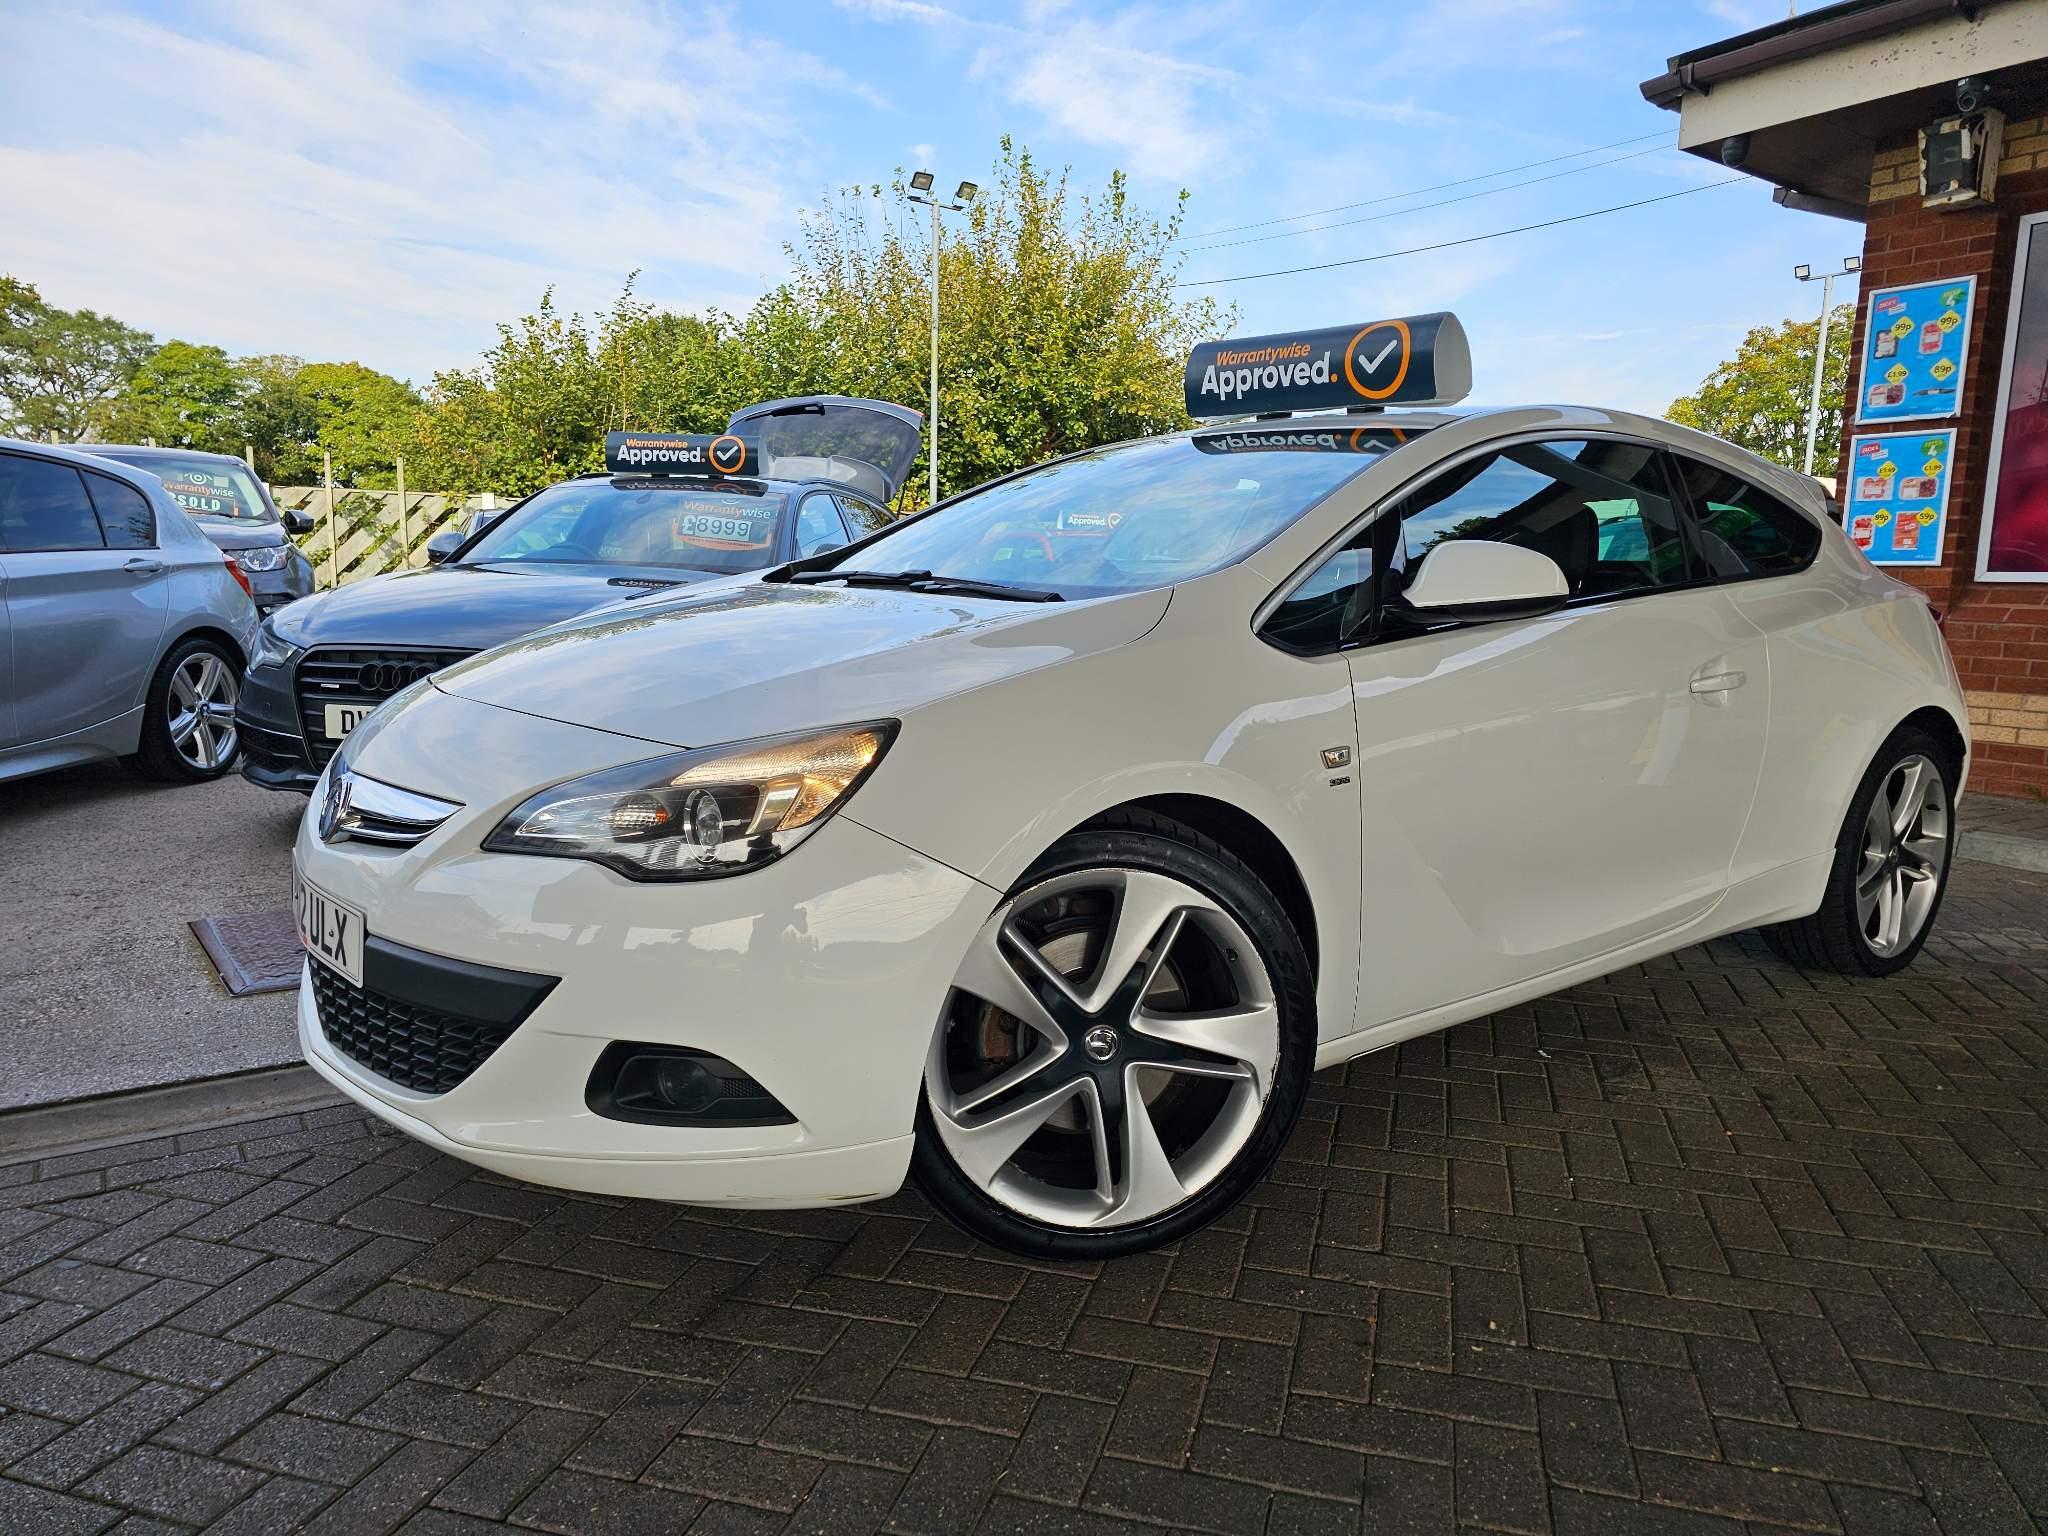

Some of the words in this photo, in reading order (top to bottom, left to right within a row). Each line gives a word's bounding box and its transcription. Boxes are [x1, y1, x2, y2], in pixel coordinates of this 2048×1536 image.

[1895, 321, 1912, 334] 99p
[1940, 316, 1958, 328] 99p
[1216, 342, 1312, 367] Warrantywise
[1201, 351, 1338, 400] Approved.
[626, 438, 689, 449] Warrantywise
[617, 444, 706, 465] Approved.
[163, 479, 234, 497] Warrantywise
[177, 494, 221, 511] SOLD
[684, 500, 771, 519] Warrantywise
[682, 515, 751, 538] £8999
[1874, 513, 1889, 523] 99p
